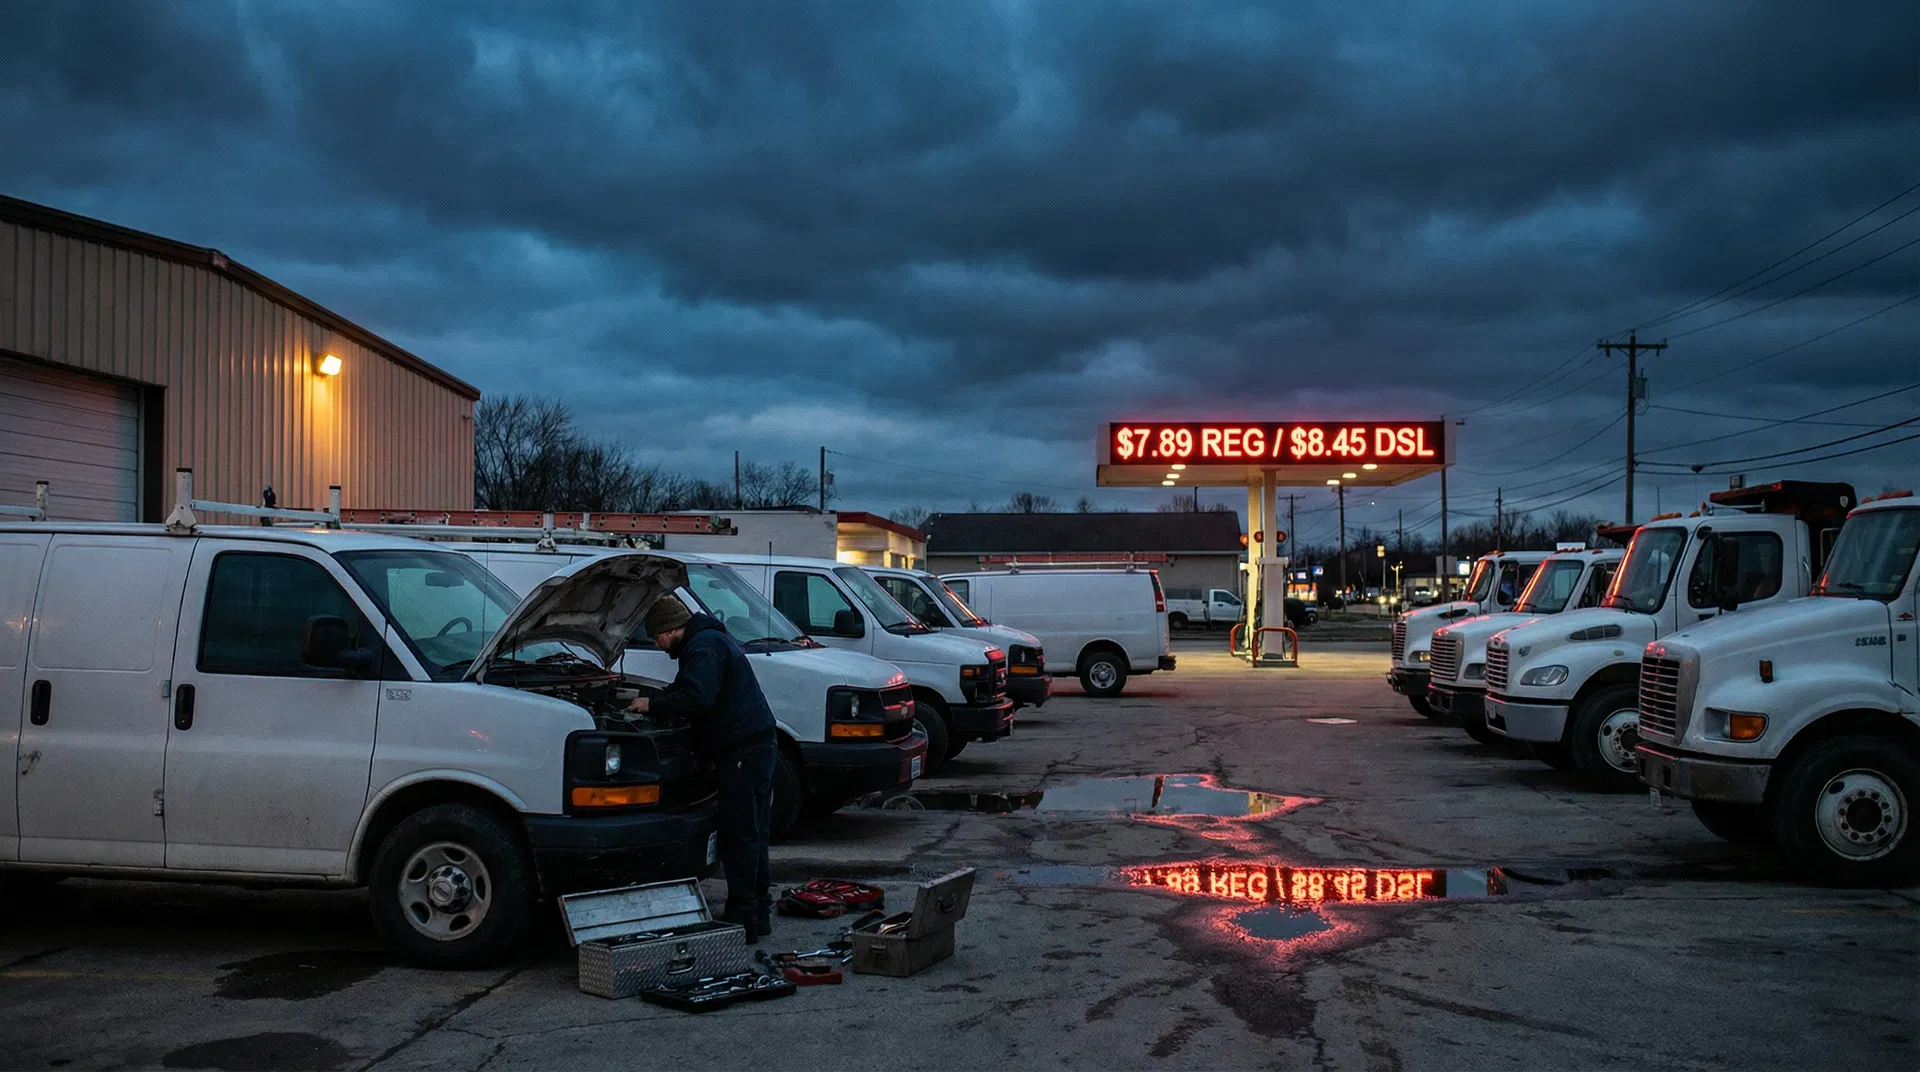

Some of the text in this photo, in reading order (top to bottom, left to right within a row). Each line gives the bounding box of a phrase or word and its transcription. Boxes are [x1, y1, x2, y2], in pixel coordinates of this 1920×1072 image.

[1116, 426, 1435, 459] $7.89 REG / $8.45 DSL
